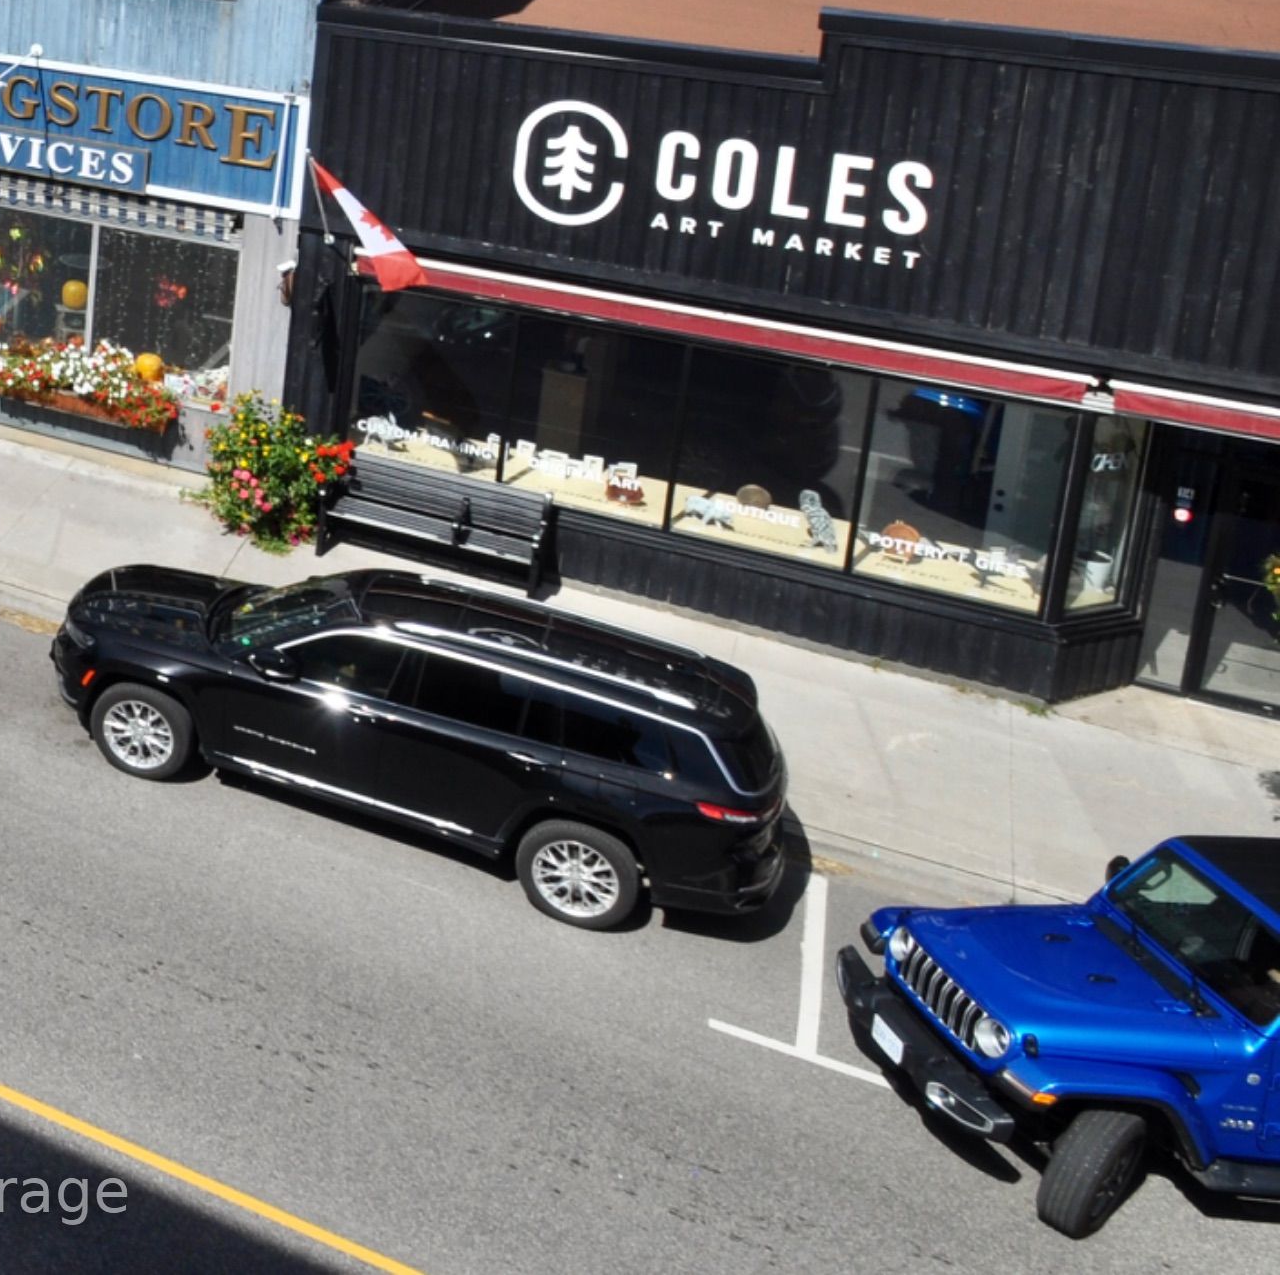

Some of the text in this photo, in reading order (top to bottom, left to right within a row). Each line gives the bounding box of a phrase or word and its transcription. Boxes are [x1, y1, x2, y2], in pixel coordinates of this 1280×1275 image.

[654, 129, 934, 236] COLES
[650, 213, 921, 270] ART MARKET
[609, 475, 642, 492] ART
[714, 498, 801, 528] BOUTIQUE
[869, 532, 948, 560] POTTERY
